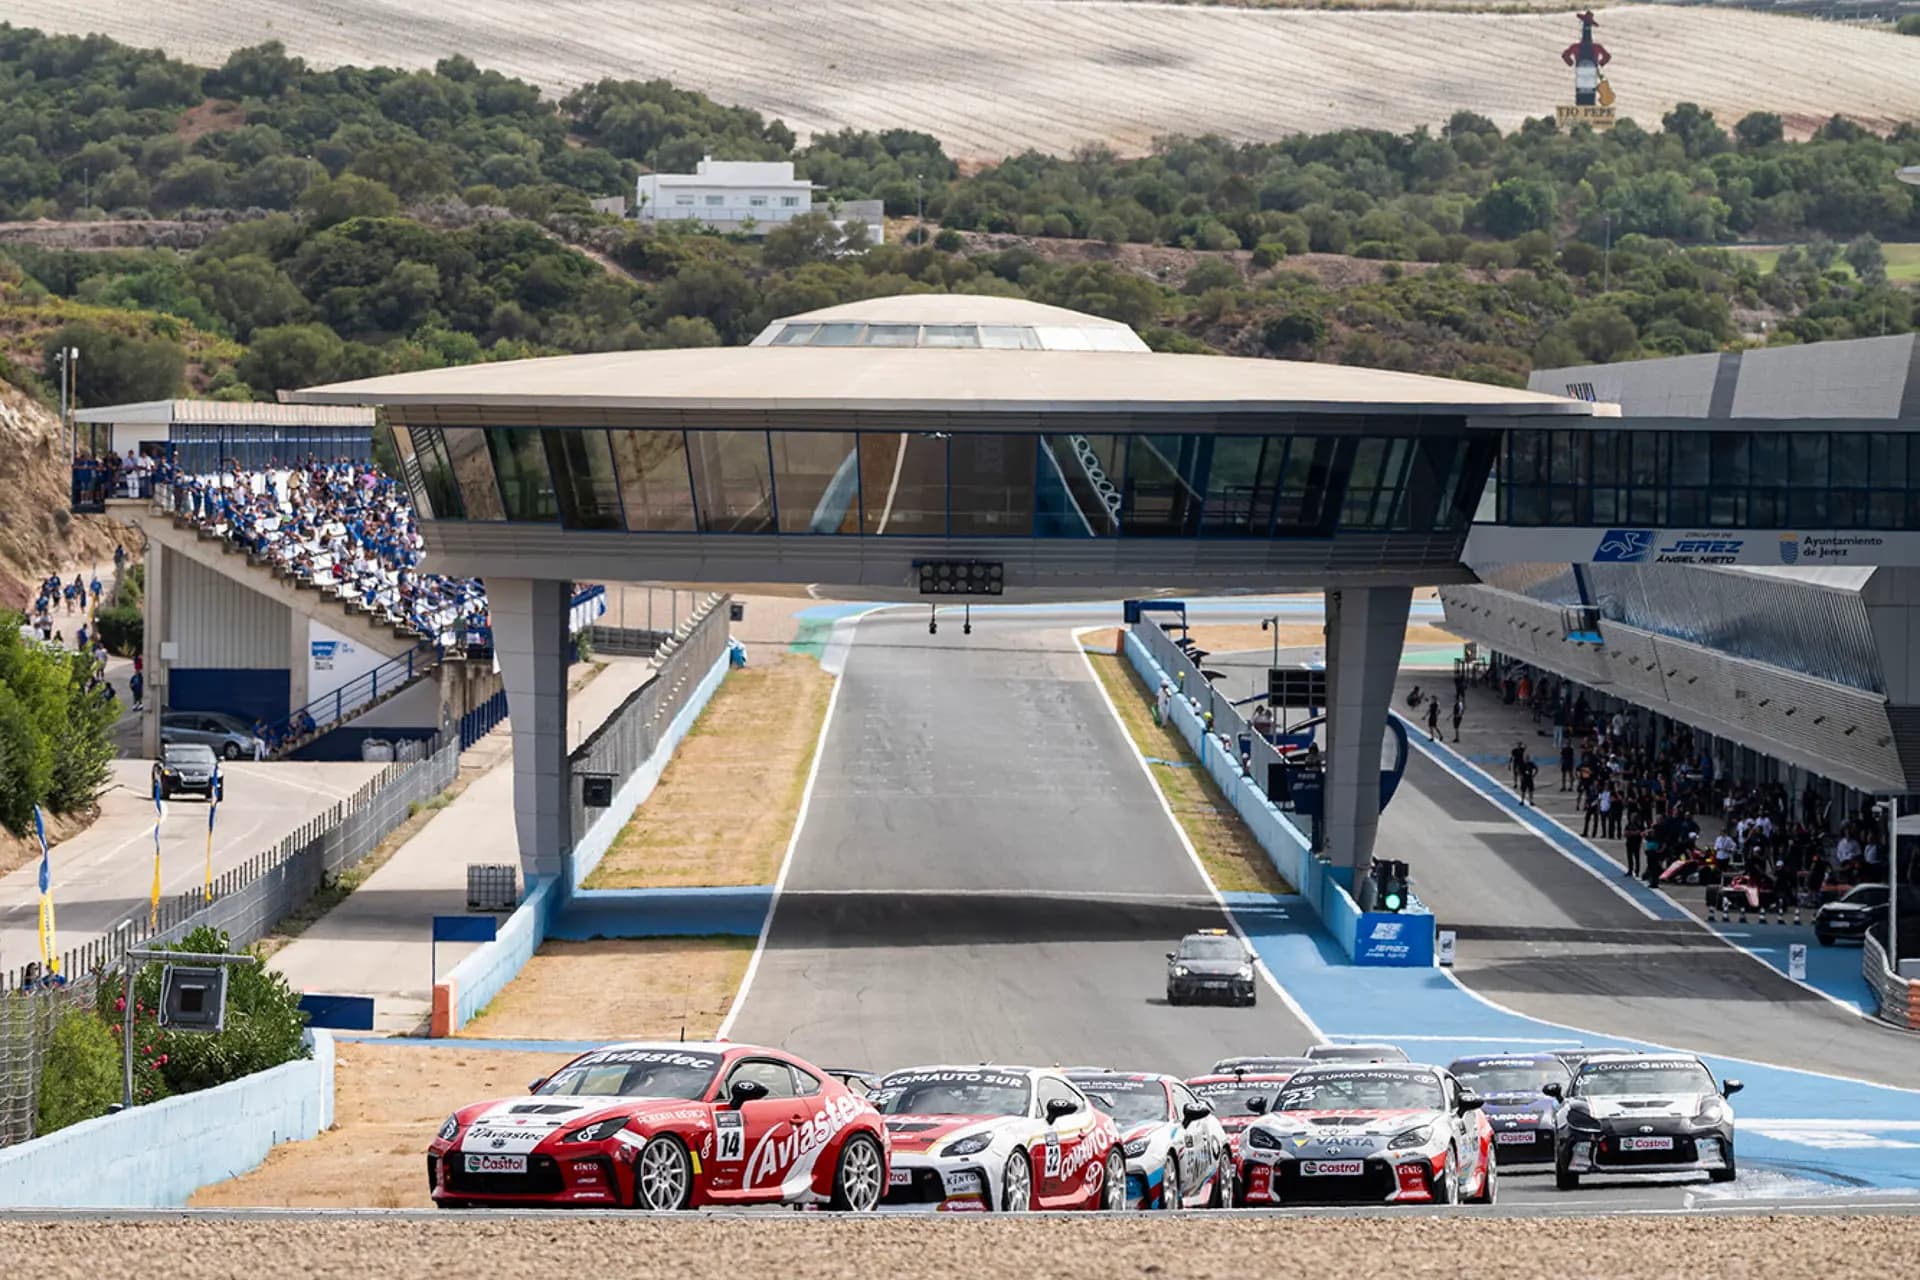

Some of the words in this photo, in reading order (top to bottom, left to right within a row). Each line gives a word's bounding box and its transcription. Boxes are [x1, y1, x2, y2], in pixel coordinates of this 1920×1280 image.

[1660, 541, 1744, 552] JEREZ
[1804, 536, 1883, 547] Ayuntamiento
[1803, 547, 1817, 556] de
[1819, 547, 1848, 558] Jerez
[1699, 556, 1736, 564] NIETO
[584, 1049, 714, 1069] Aviastec
[884, 1072, 982, 1087] COMAUTO
[983, 1074, 1023, 1087] SUR
[1367, 1071, 1410, 1080] MOTOR
[481, 1129, 545, 1141] Aviastec
[754, 1092, 866, 1185] Aviastec
[721, 1131, 740, 1157] 14
[1316, 1137, 1375, 1148] VARTA
[1634, 1138, 1671, 1148] Castrol
[481, 1157, 524, 1170] Castrol
[1318, 1162, 1361, 1173] Castrol
[890, 1171, 908, 1182] trol
